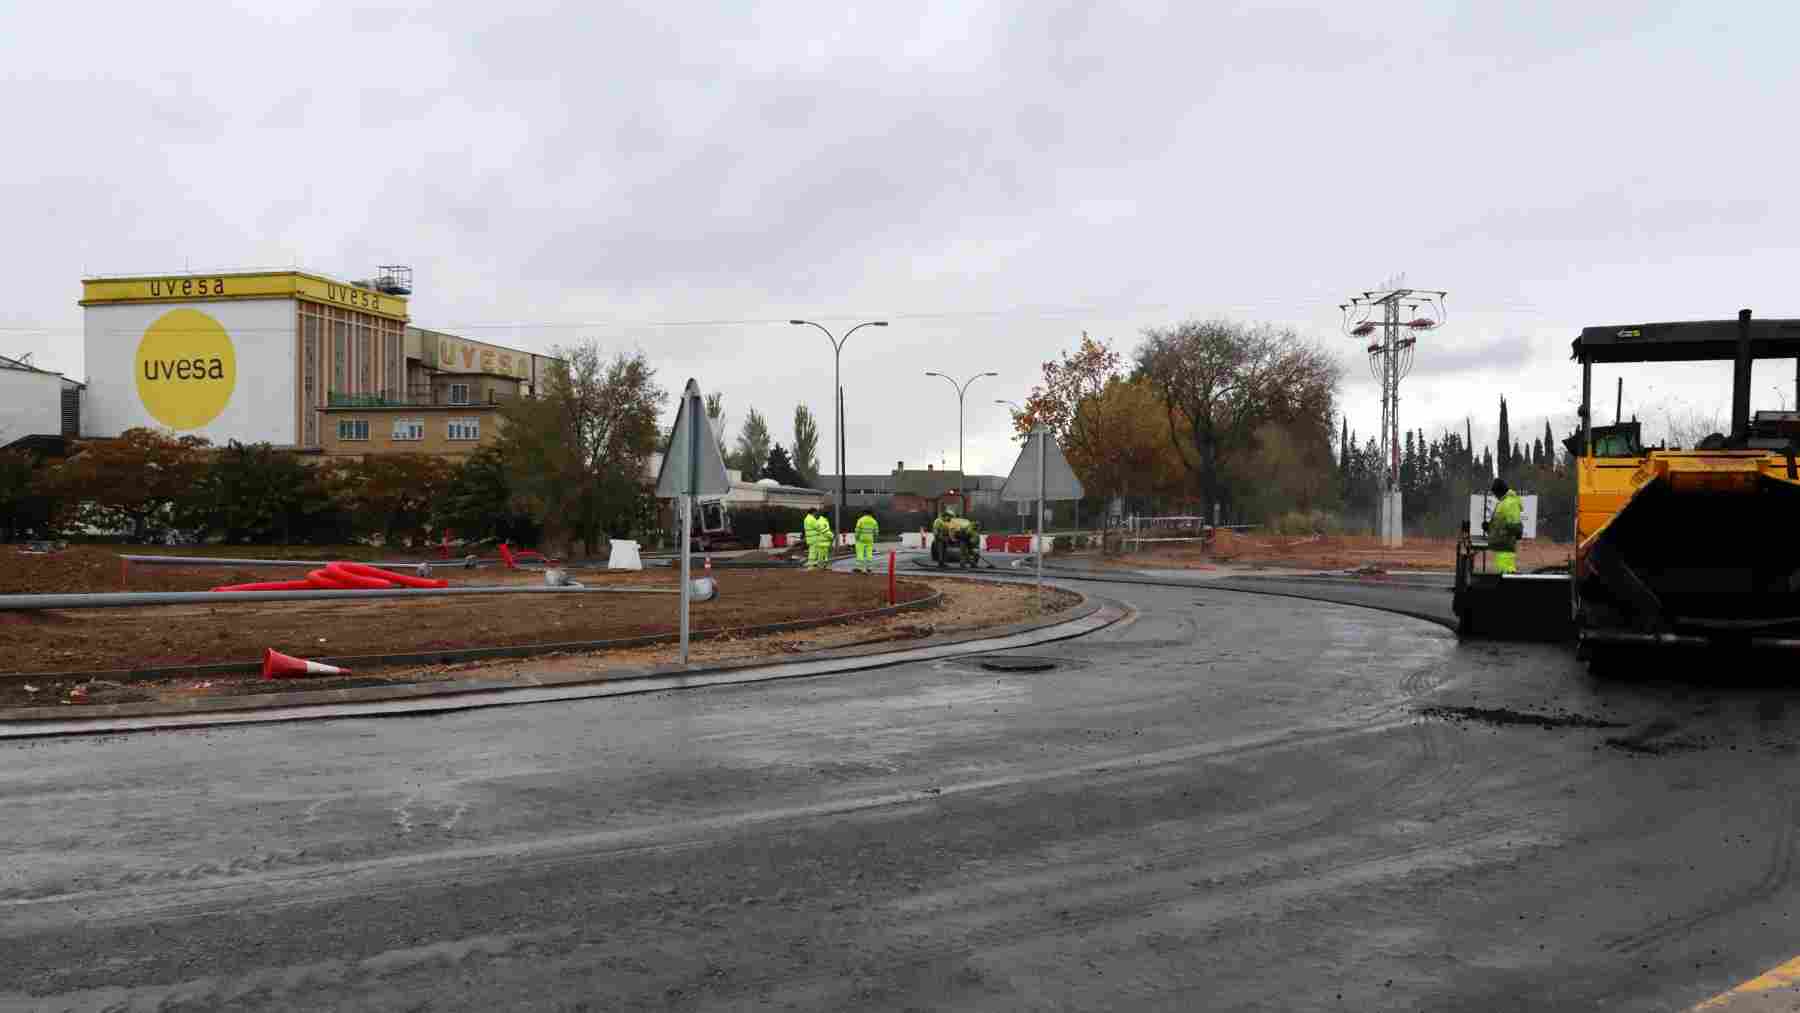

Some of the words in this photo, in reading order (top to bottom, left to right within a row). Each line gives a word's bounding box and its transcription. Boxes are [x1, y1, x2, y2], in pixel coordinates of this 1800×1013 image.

[151, 278, 225, 297] uvesa
[327, 282, 380, 310] uvesa
[144, 358, 225, 380] uvesa
